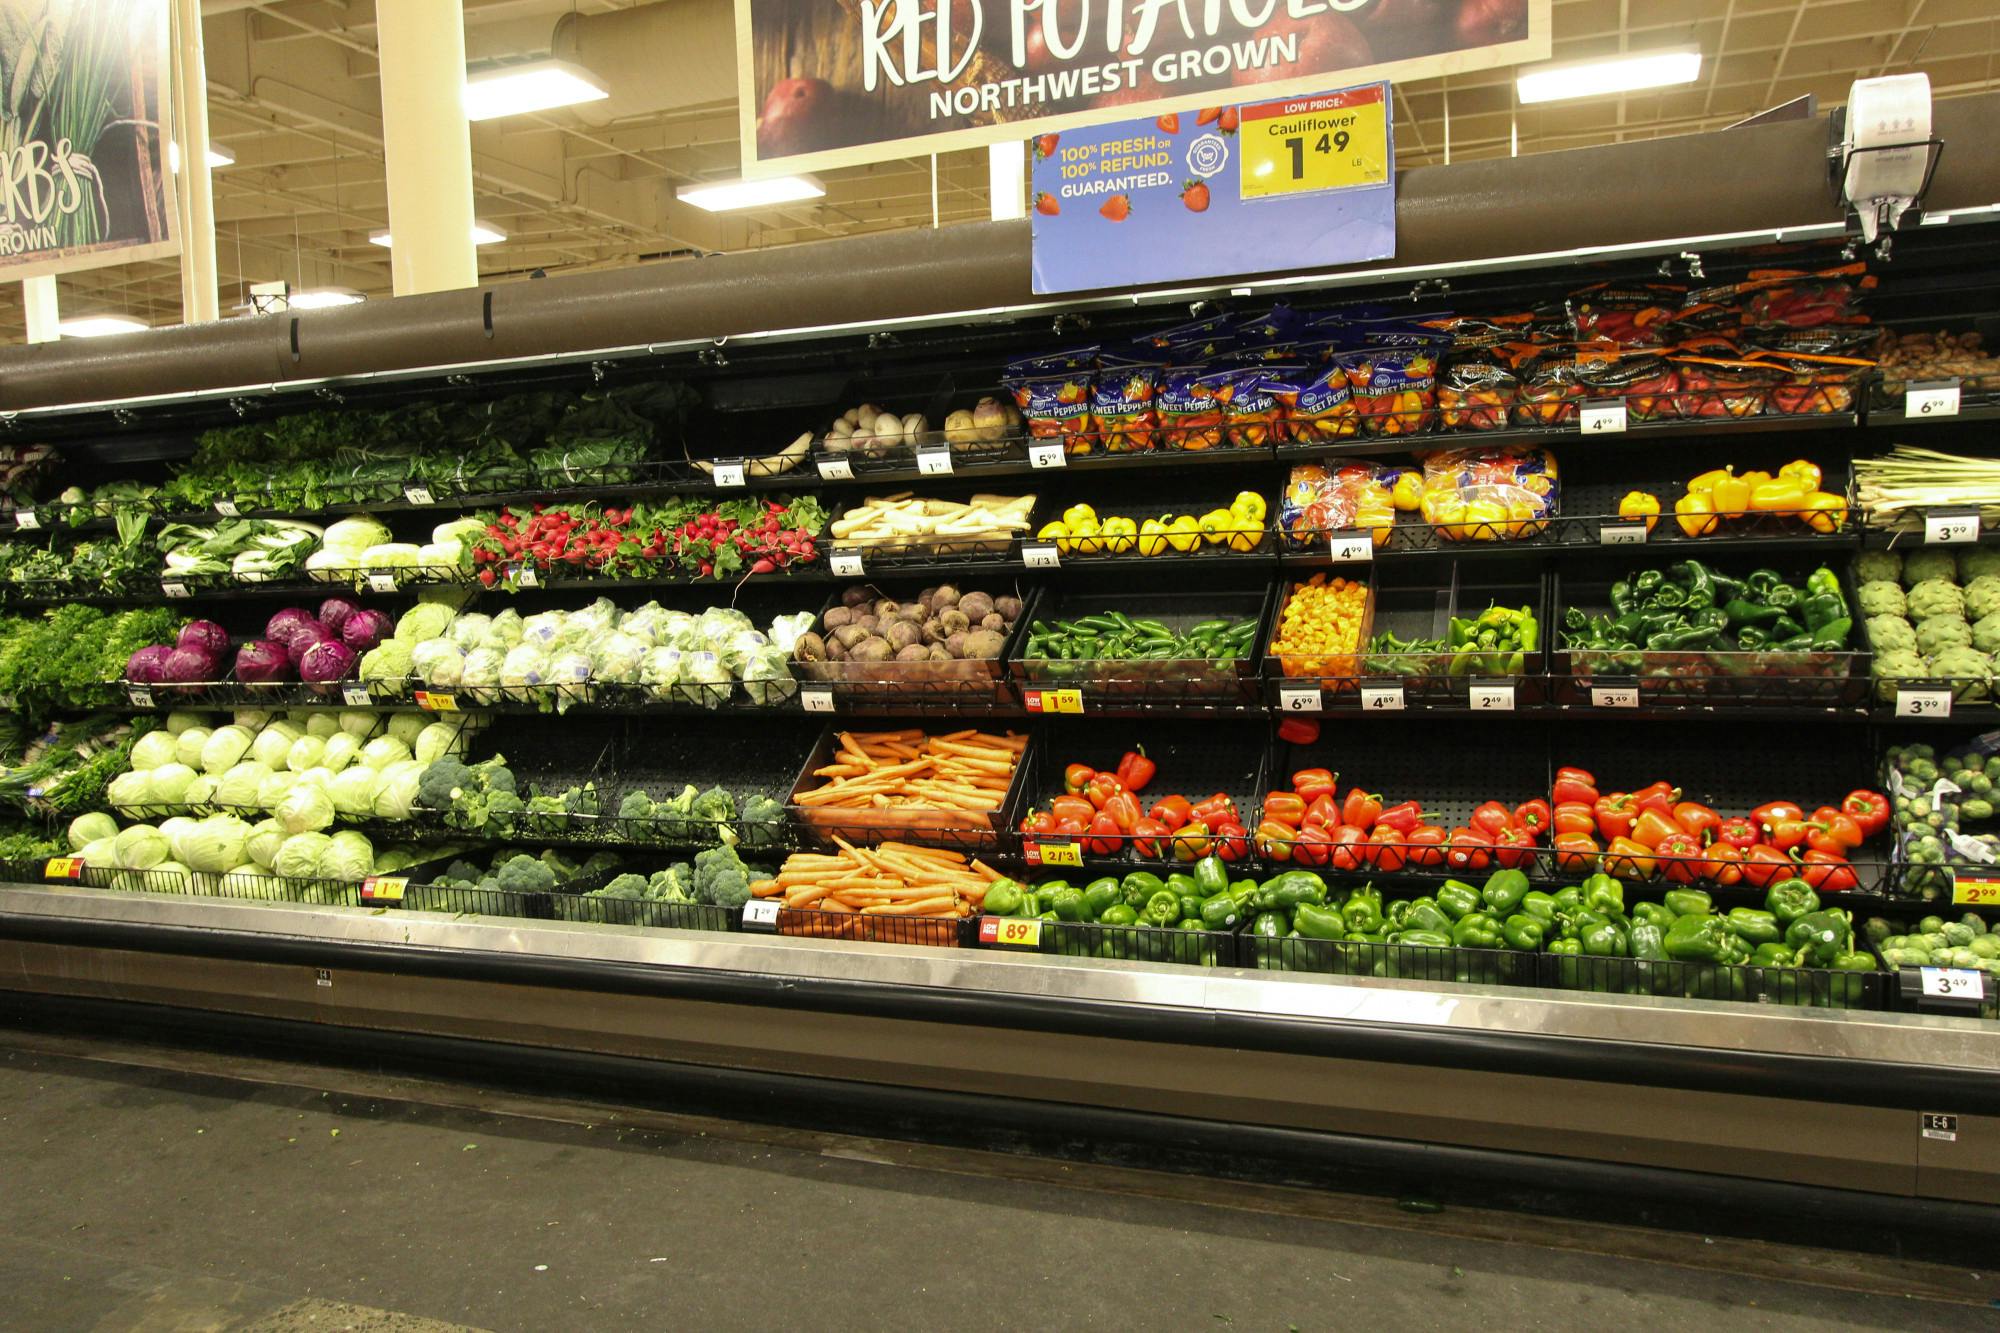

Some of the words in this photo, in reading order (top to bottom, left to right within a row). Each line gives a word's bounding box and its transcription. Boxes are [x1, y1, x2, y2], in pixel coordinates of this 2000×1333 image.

[861, 0, 983, 92] RED
[930, 59, 1143, 119] NORTHWEST
[1152, 33, 1297, 82] GROWN
[1284, 102, 1307, 114] LOW
[1269, 115, 1357, 136] Cauliflower
[1061, 144, 1098, 162] 100%
[1101, 135, 1156, 157] FRESH
[1157, 140, 1171, 149] OR
[1061, 161, 1097, 179] 100%
[1100, 151, 1173, 174] REFUND.
[1351, 158, 1362, 167] LB
[0, 138, 82, 223] RBS
[1061, 172, 1173, 198] GUARANTEED.
[1039, 453, 1057, 466] 599
[1939, 526, 1967, 541] 399
[1340, 546, 1362, 559] 499
[1291, 697, 1313, 710] 699
[1482, 697, 1501, 708] 249
[1604, 696, 1628, 706] 349
[1910, 700, 1938, 714] 399
[1966, 887, 1998, 903] 299
[1938, 977, 1968, 994] 349
[1933, 1115, 1948, 1129] E-6
